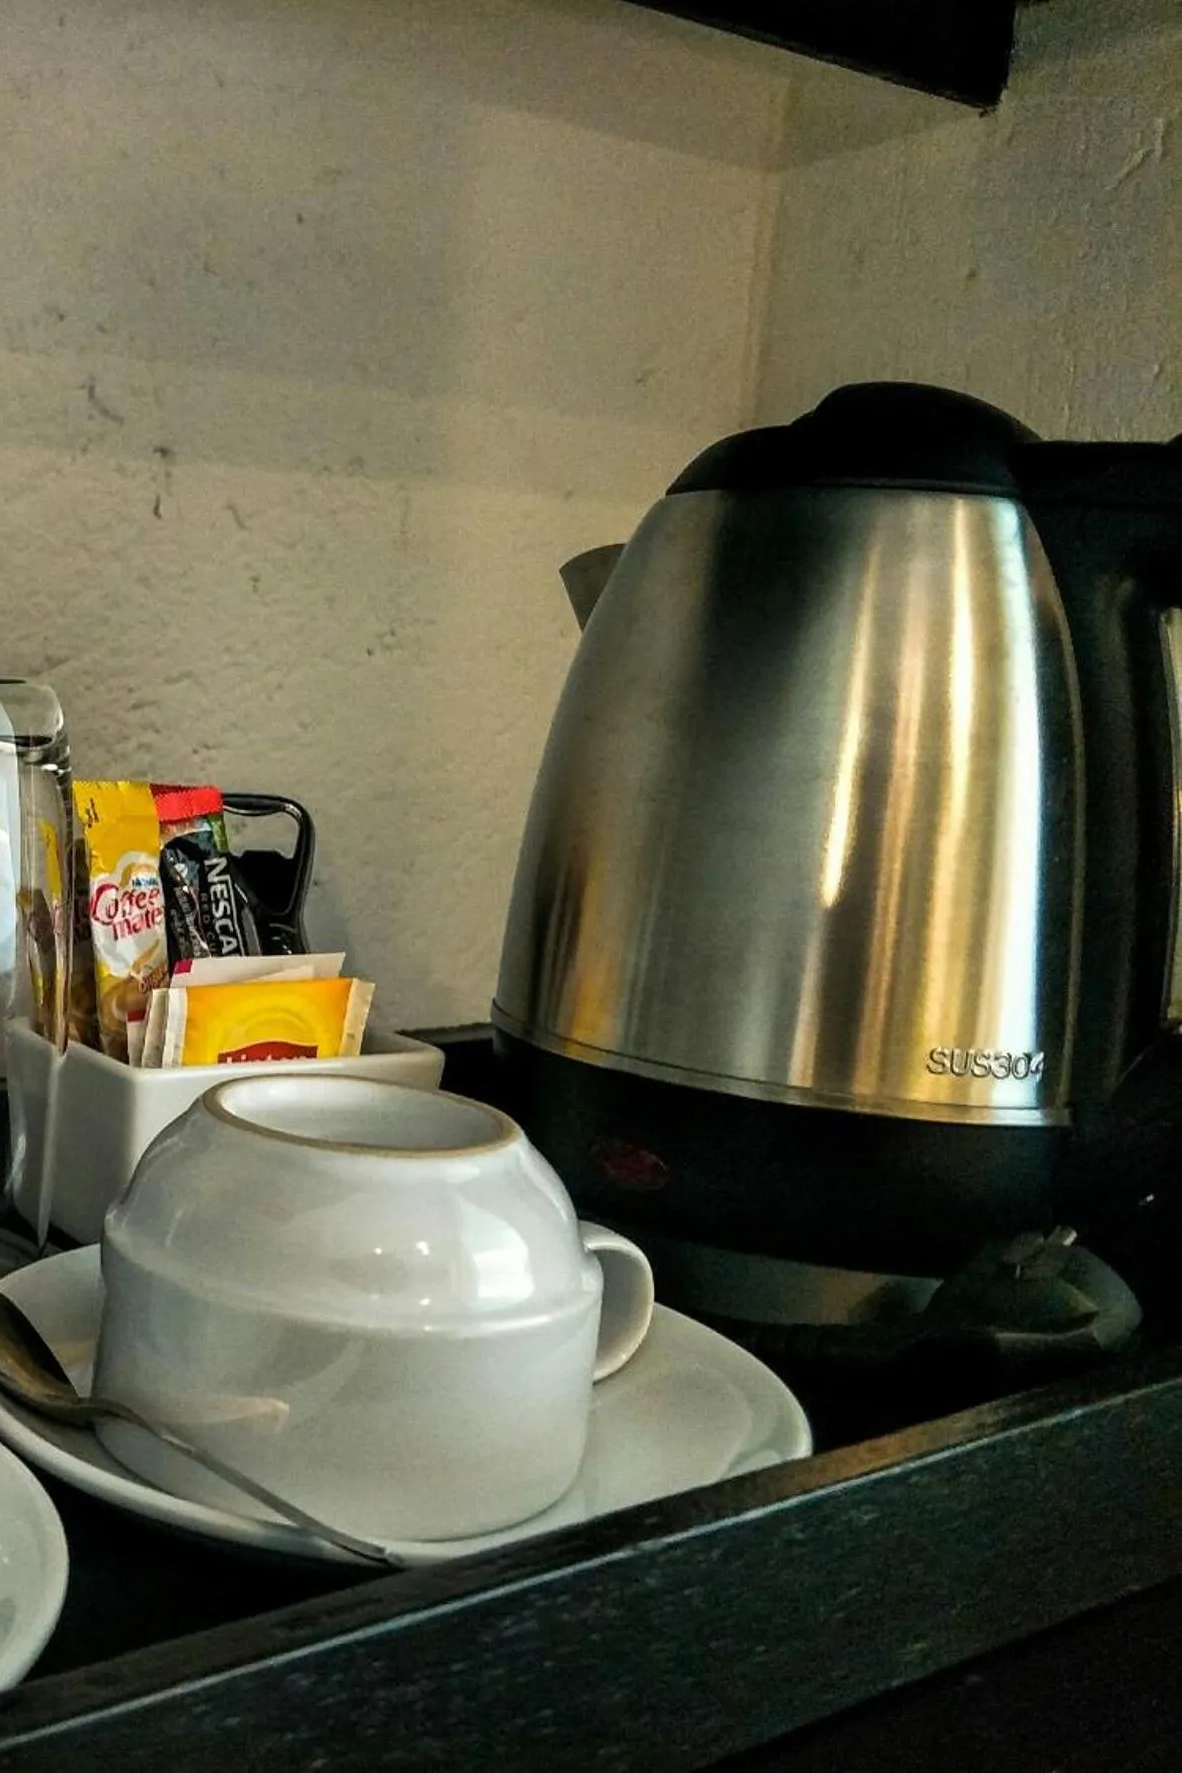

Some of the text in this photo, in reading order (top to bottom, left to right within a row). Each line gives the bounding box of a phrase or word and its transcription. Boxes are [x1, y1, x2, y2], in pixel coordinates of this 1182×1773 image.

[90, 882, 161, 926] Coffee
[203, 857, 244, 957] NESCA
[926, 1046, 1045, 1079] SUS304
